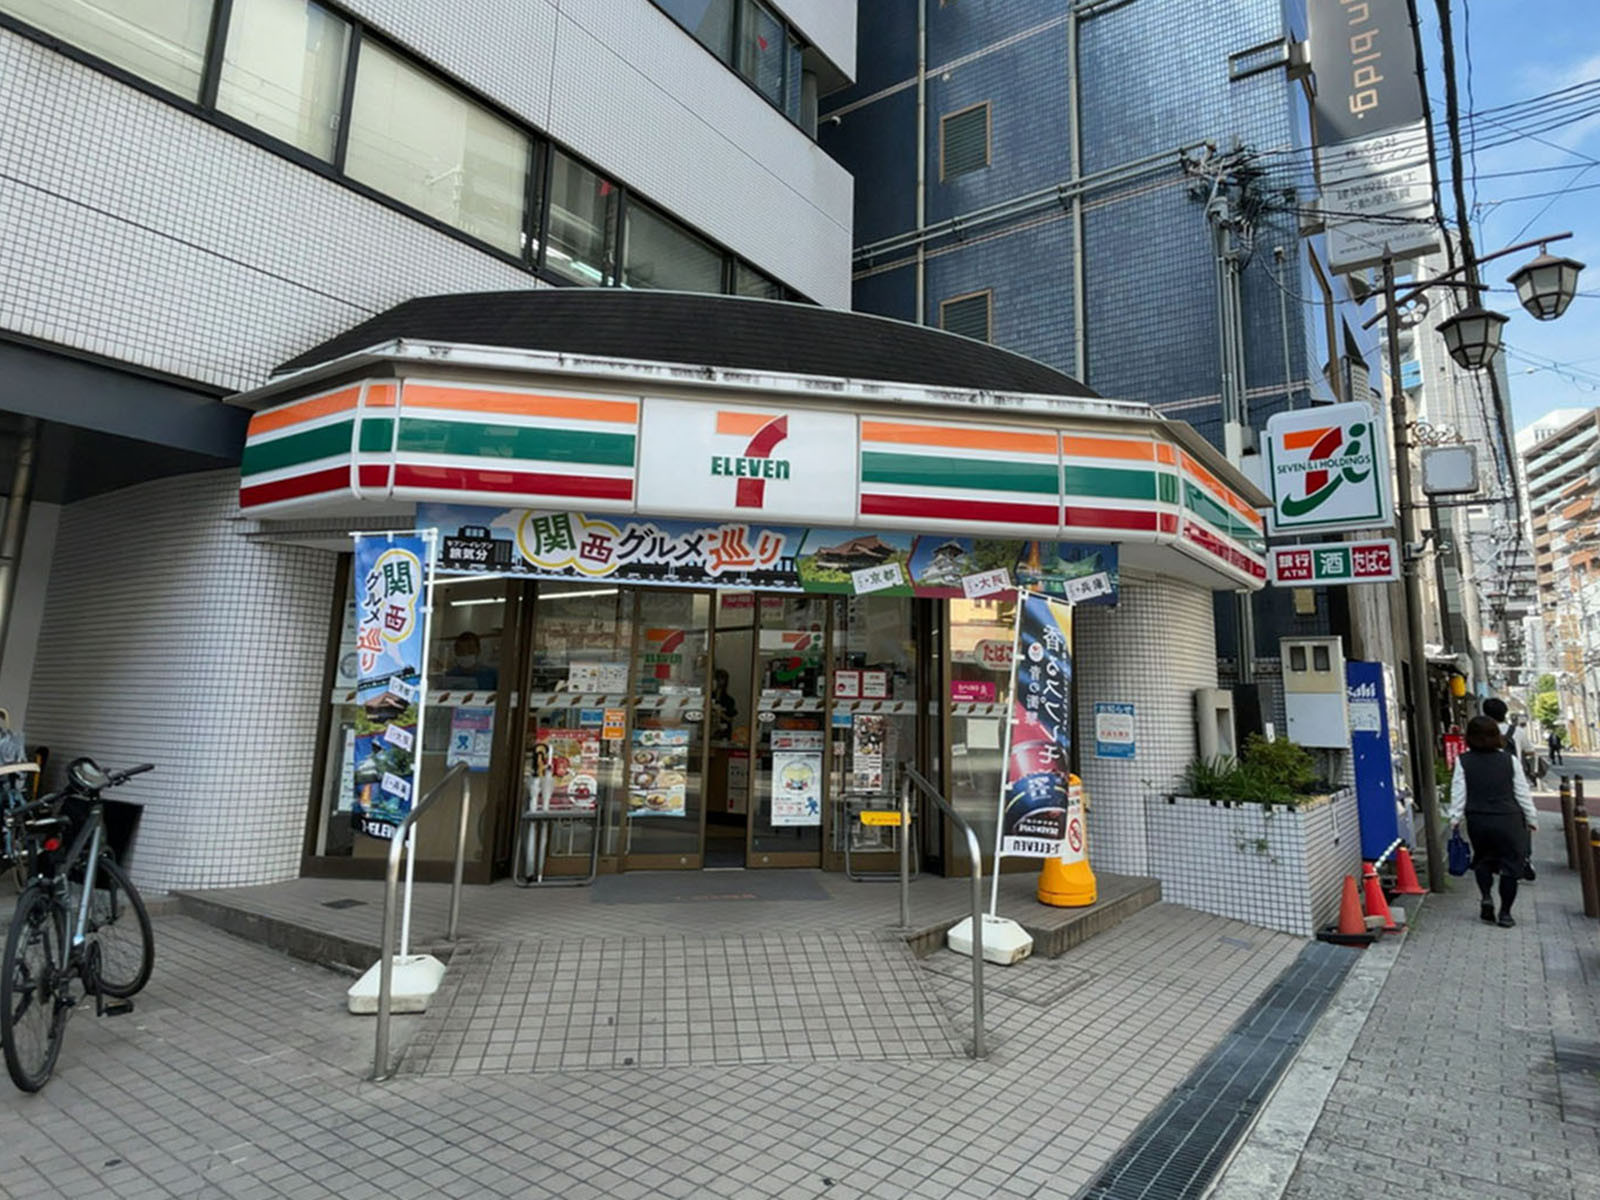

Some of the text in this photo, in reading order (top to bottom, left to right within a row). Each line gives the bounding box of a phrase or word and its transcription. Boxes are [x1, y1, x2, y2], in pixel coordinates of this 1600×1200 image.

[1348, 28, 1385, 119] bldg.
[716, 411, 788, 508] 7
[1320, 454, 1371, 469] HOLDINGS
[532, 511, 783, 570] 関西グルメ巡り
[1278, 554, 1311, 568] 銀行
[1353, 549, 1392, 574] たばこ
[1282, 568, 1309, 577] ATM
[1320, 552, 1344, 574] 酒
[383, 560, 414, 633] 関西
[357, 571, 383, 671] グルメ巡り
